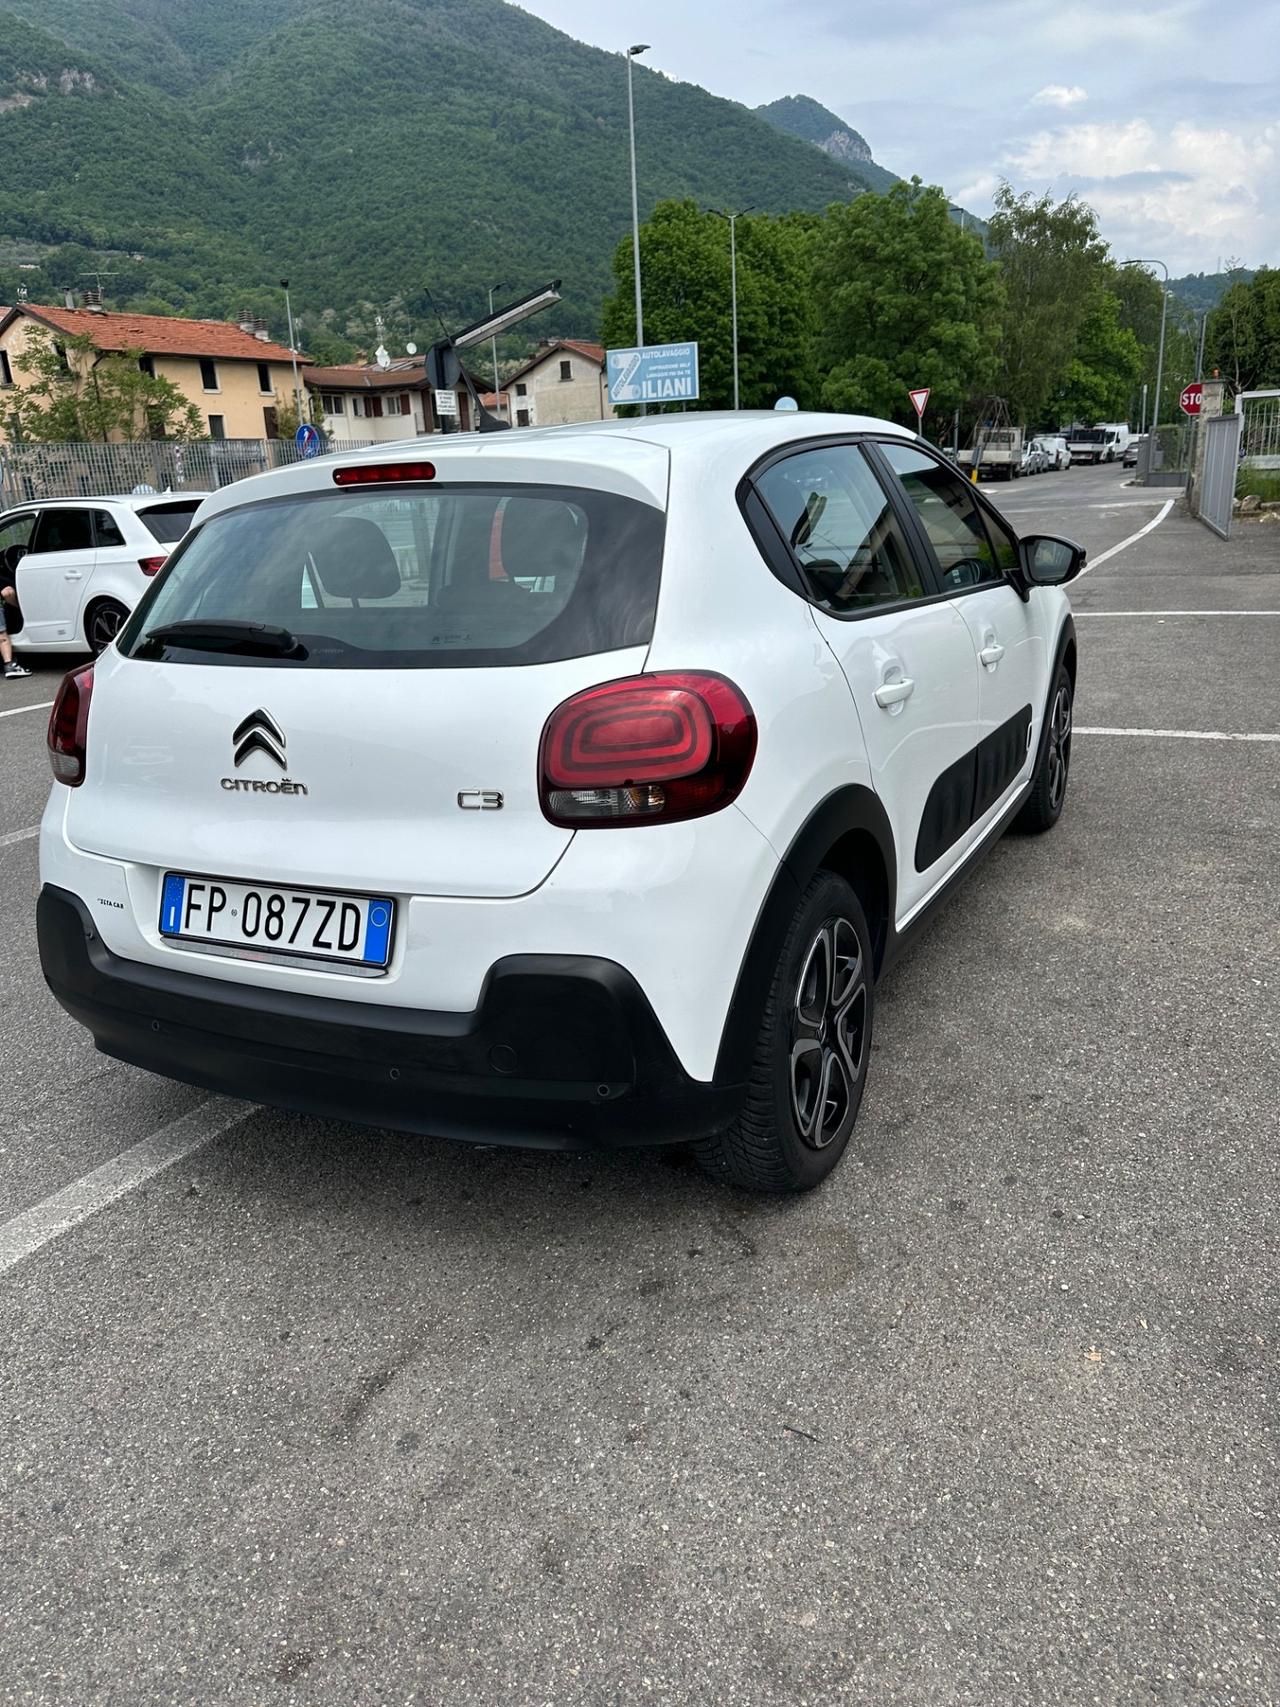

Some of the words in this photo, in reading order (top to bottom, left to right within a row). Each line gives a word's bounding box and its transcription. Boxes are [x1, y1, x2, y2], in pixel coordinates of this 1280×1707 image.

[642, 348, 690, 359] AUTOLAVAGGIO
[1182, 393, 1201, 405] STO
[457, 790, 504, 810] C3
